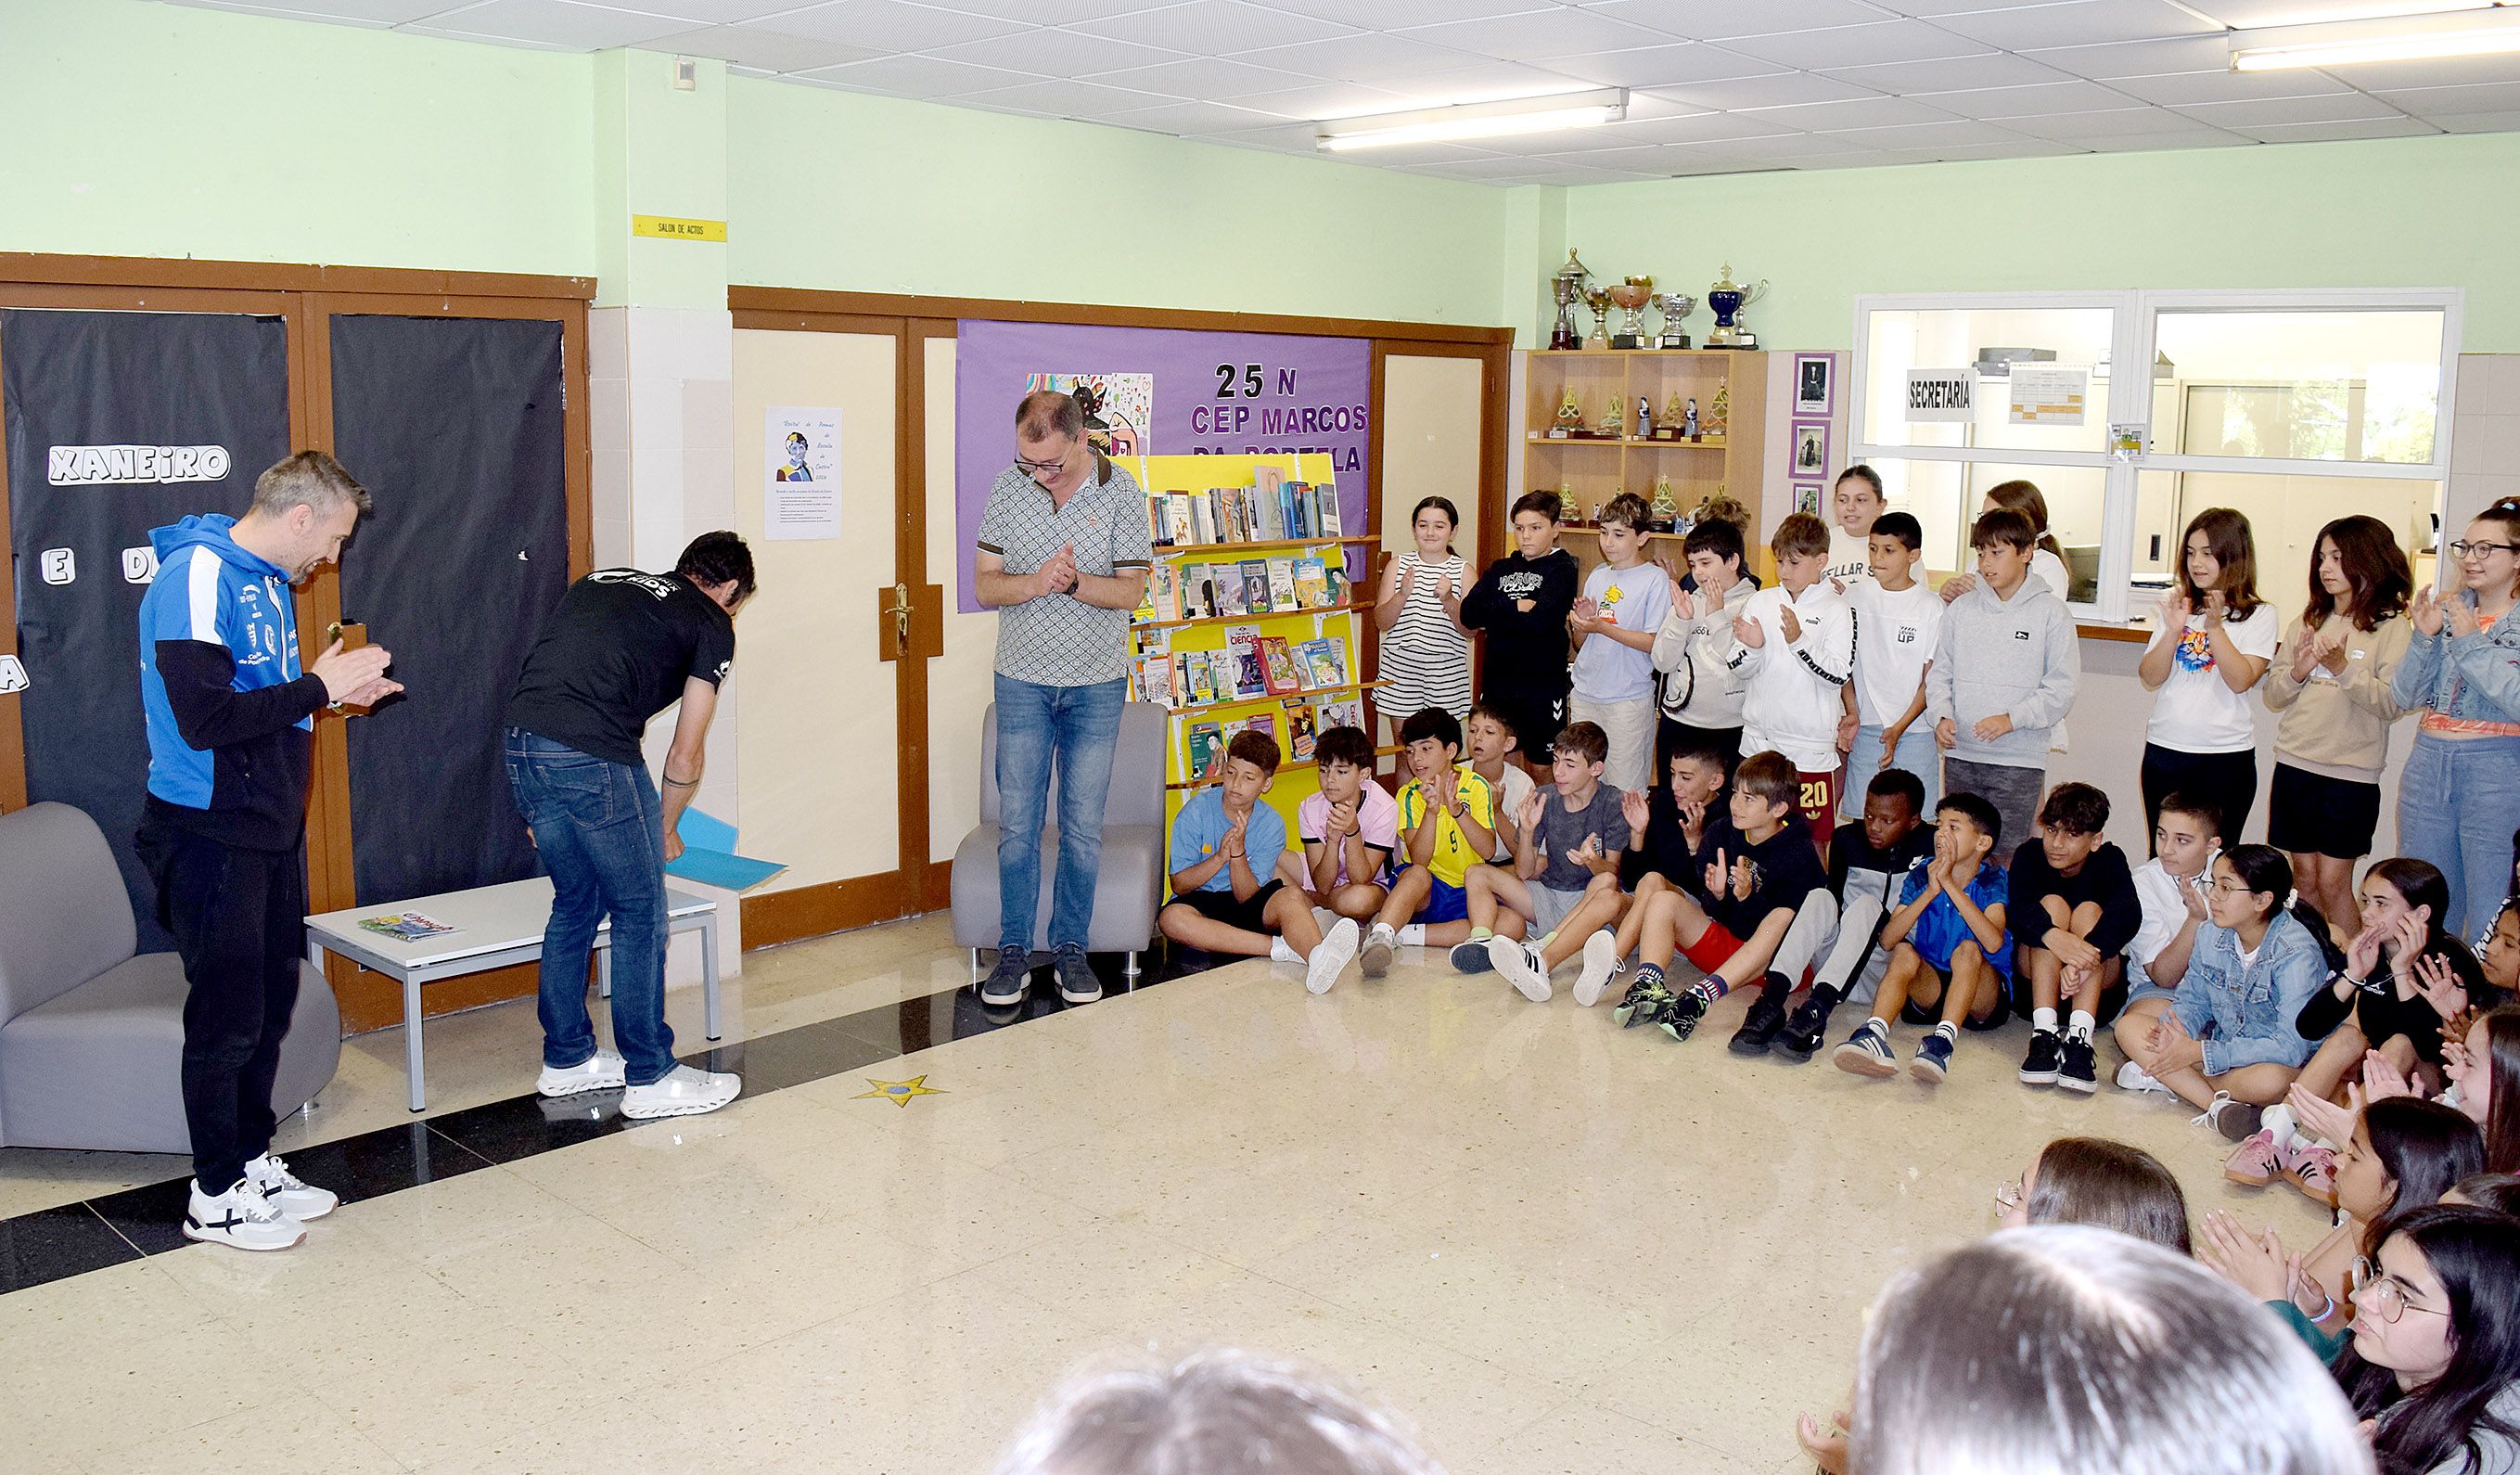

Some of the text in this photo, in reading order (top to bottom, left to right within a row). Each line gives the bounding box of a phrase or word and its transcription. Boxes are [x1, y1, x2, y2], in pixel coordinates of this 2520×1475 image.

[658, 223, 704, 235] SALON DE ACTOS
[1215, 363, 1297, 399] 25 N
[1909, 374, 1970, 409] SECRETARÍA
[1191, 404, 1367, 435] CEP MARCOS
[48, 550, 69, 582] E
[1898, 635, 1914, 643] UP
[1799, 780, 1828, 808] 20
